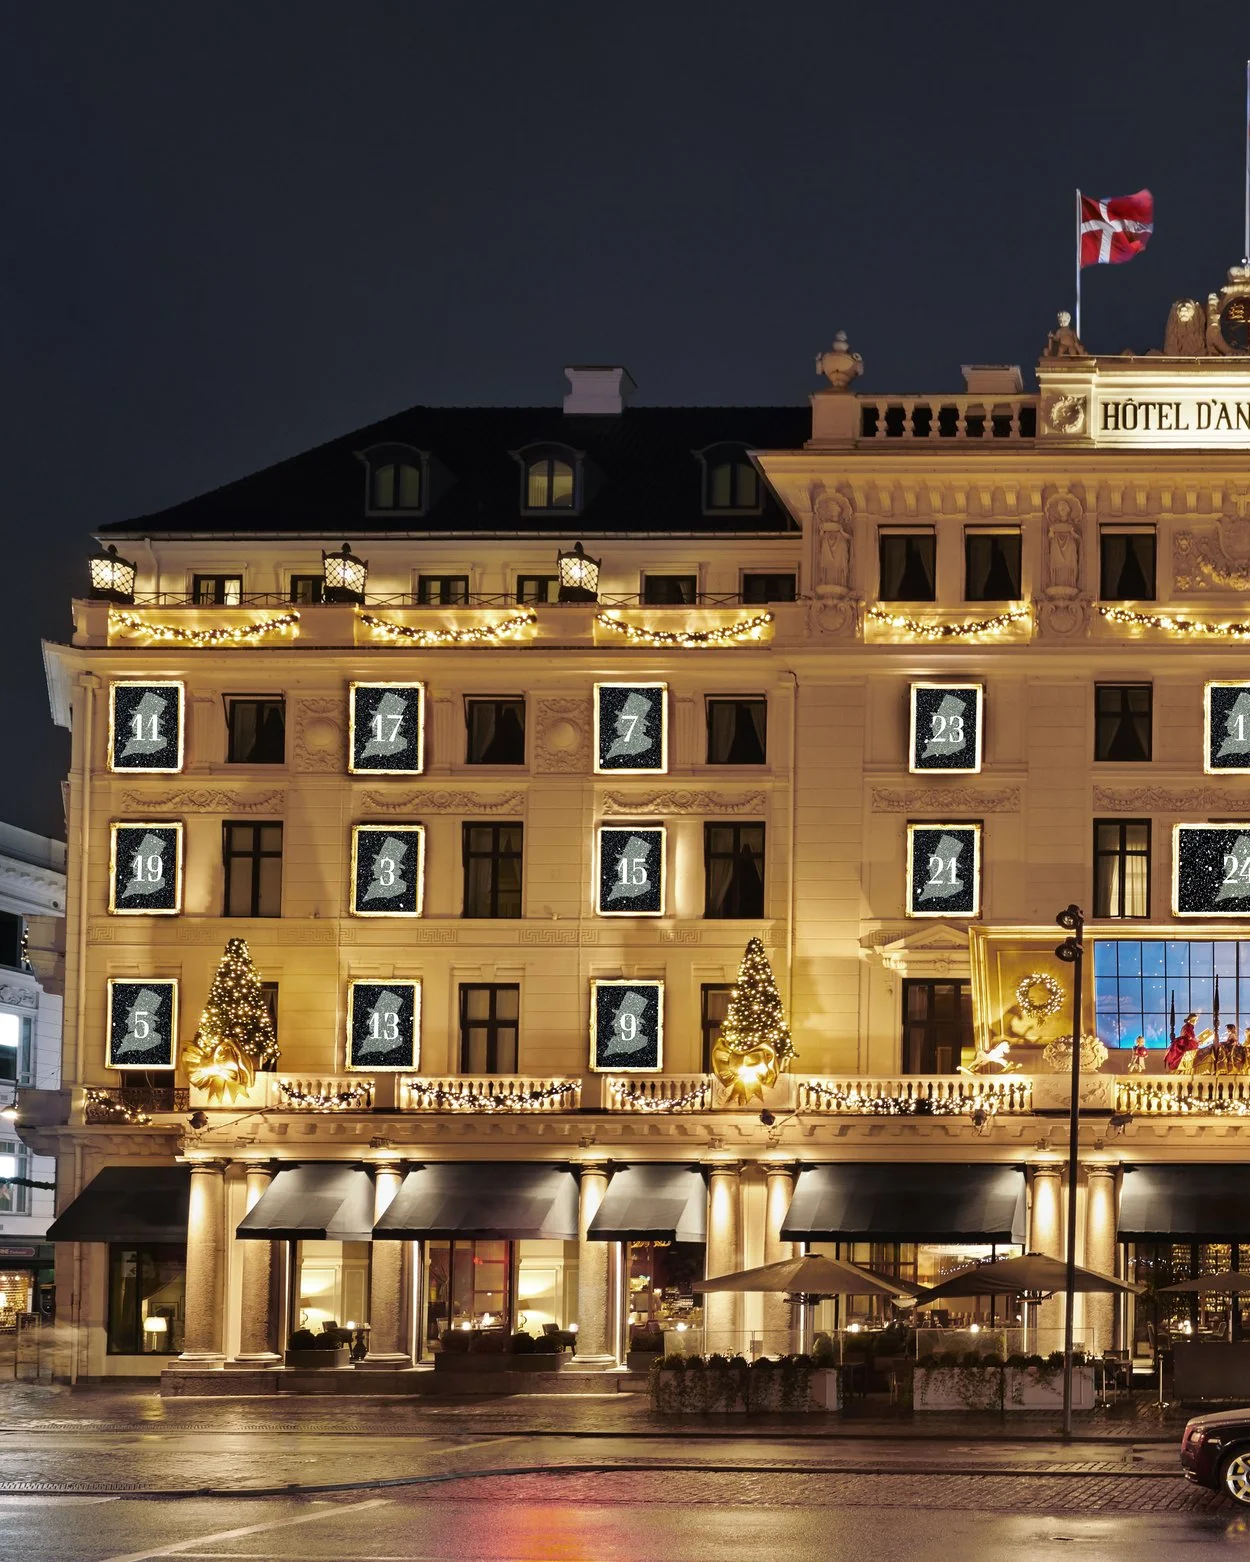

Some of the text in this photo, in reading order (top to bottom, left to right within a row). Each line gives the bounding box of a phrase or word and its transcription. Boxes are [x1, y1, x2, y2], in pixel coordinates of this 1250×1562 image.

[1100, 398, 1189, 430] HÔTEL
[131, 713, 162, 742] 11
[371, 713, 404, 743] 17
[621, 714, 639, 743] 7
[930, 714, 964, 743] 23
[1233, 714, 1248, 742] 1
[132, 854, 163, 883] 19
[379, 856, 395, 886] 3
[617, 857, 648, 885] 15
[928, 856, 960, 885] 21
[133, 1010, 150, 1039] 5
[368, 1012, 400, 1041] 13
[619, 1013, 637, 1041] 9
